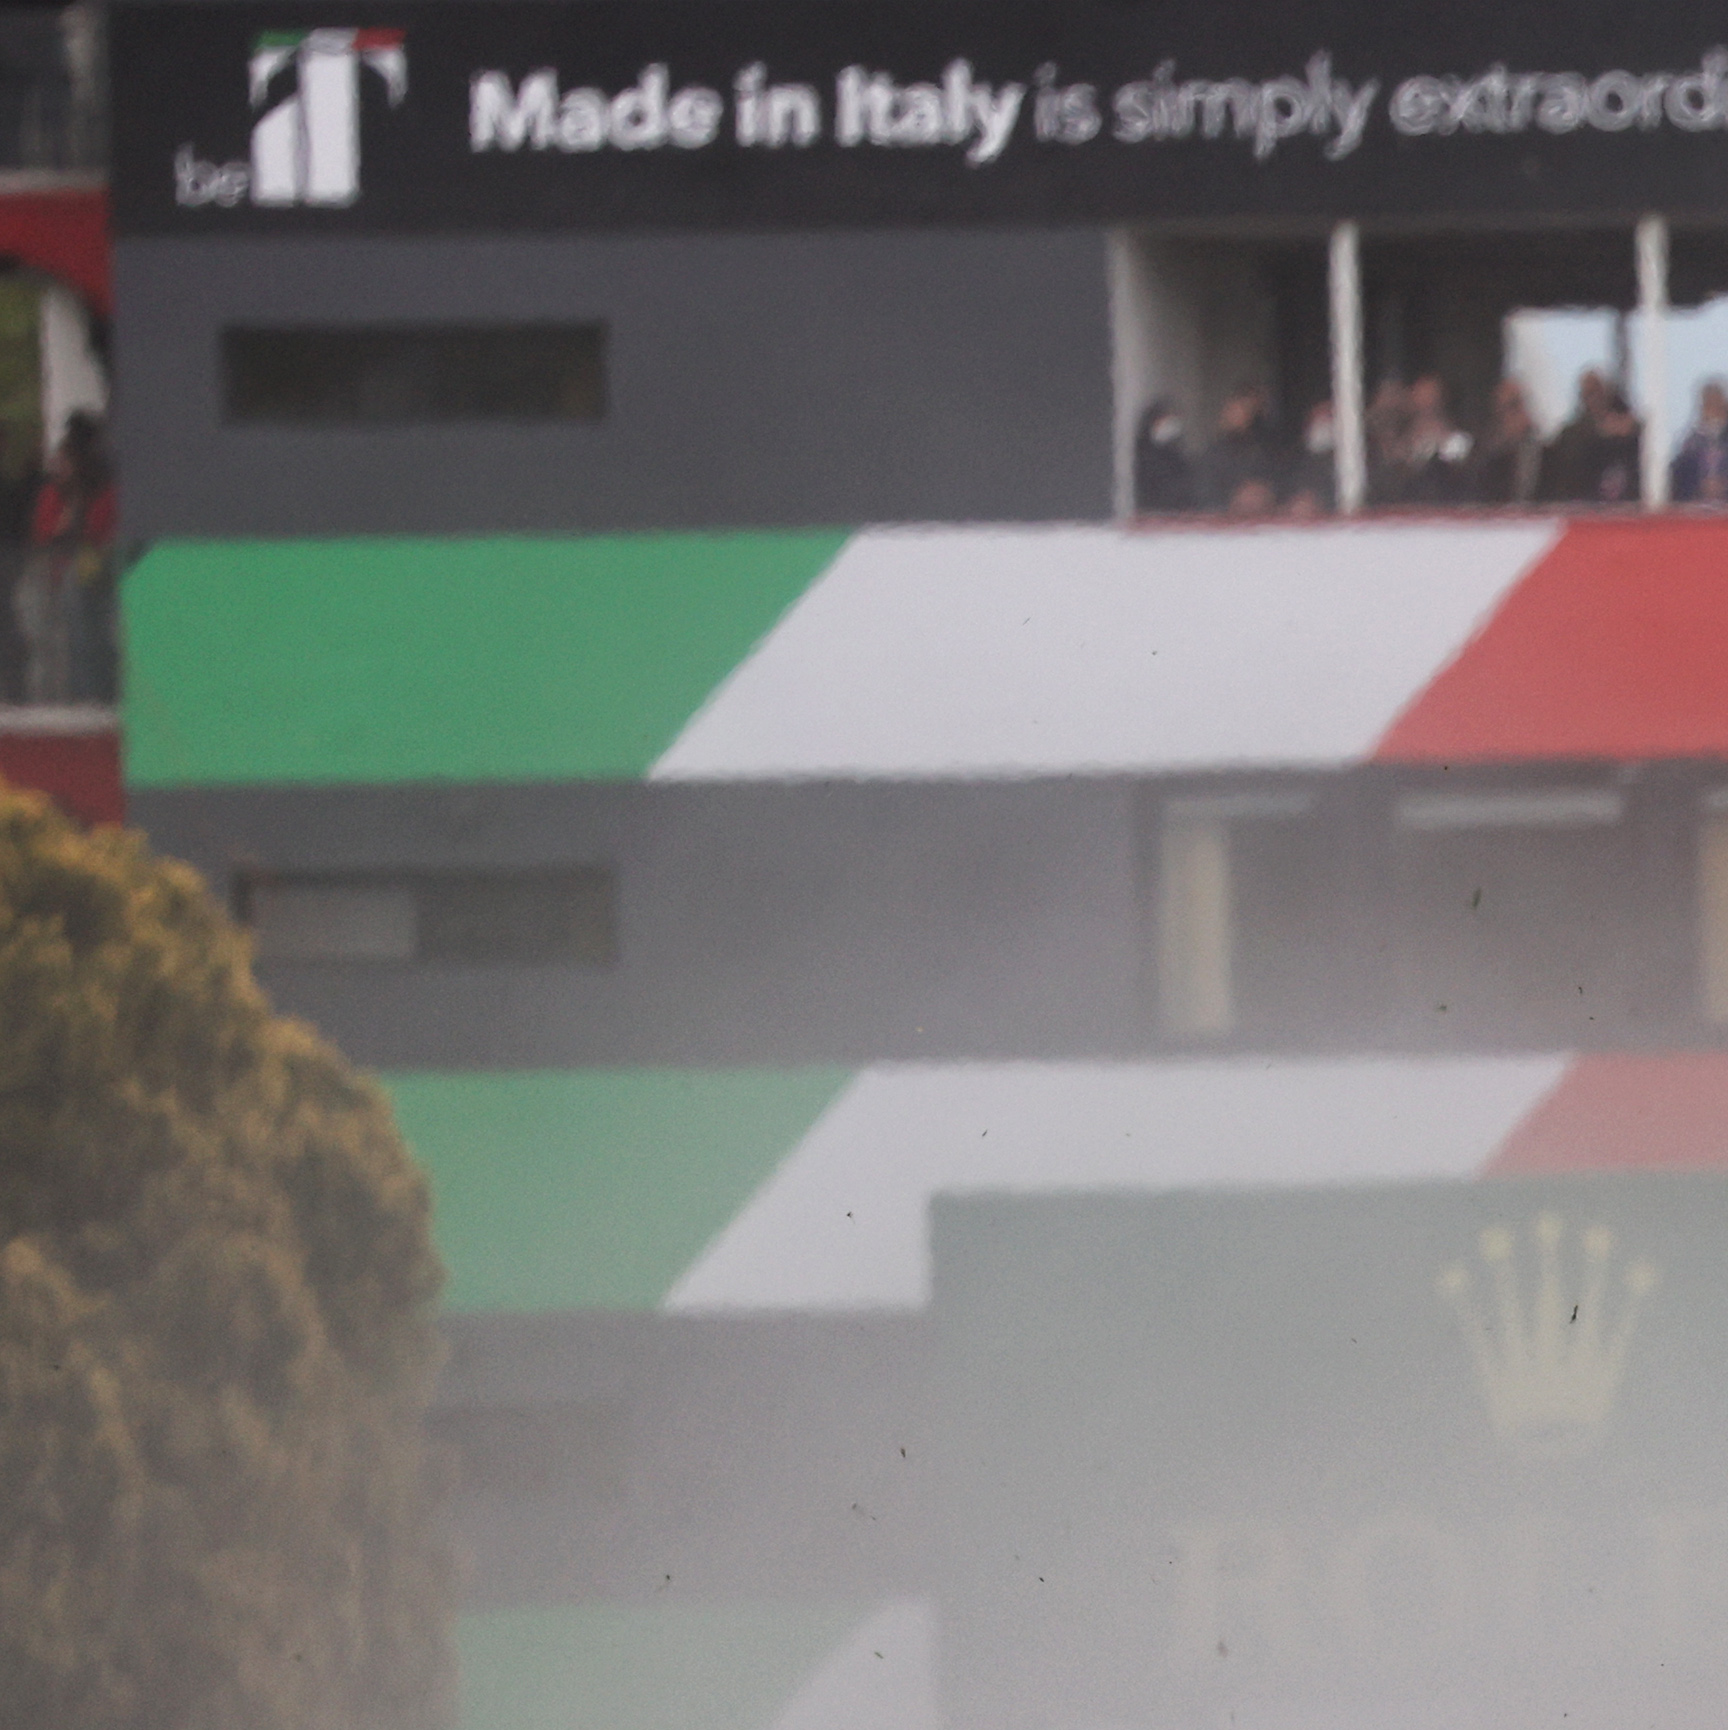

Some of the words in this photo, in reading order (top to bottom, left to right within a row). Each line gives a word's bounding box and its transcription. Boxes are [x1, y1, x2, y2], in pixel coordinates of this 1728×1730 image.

[470, 62, 723, 152] Made
[735, 61, 820, 148] in
[836, 57, 1026, 168] Italy
[1035, 61, 1101, 143] is
[1112, 49, 1379, 161] simply
